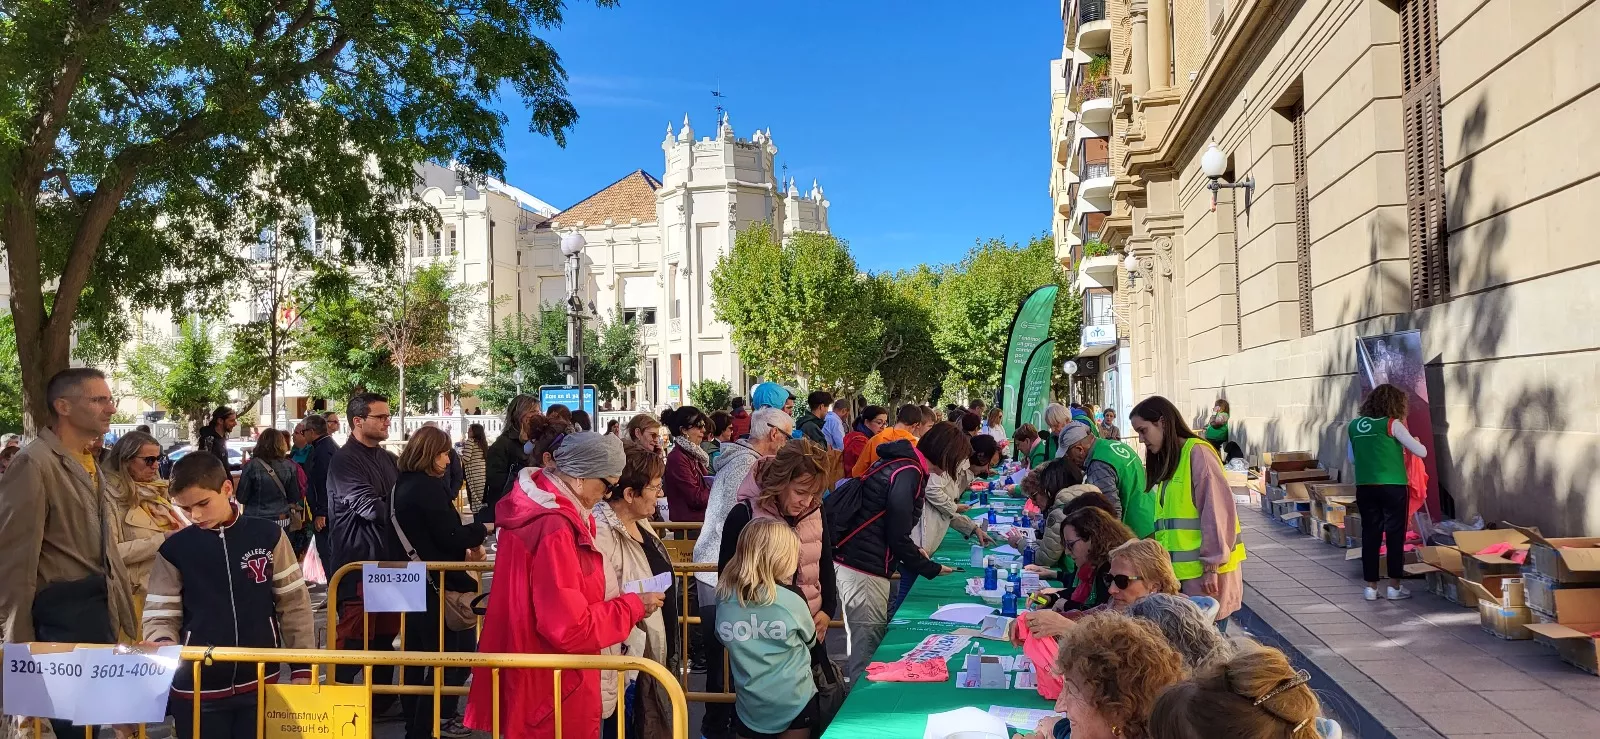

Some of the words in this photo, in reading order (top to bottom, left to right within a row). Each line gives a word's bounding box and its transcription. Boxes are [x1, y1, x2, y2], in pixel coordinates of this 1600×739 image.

[241, 548, 266, 561] COLLEGE
[248, 556, 268, 584] Y
[368, 573, 420, 583] 2801-3200
[719, 614, 787, 642] soka
[10, 659, 83, 677] 3201-3600
[90, 662, 166, 679] 3601-4000
